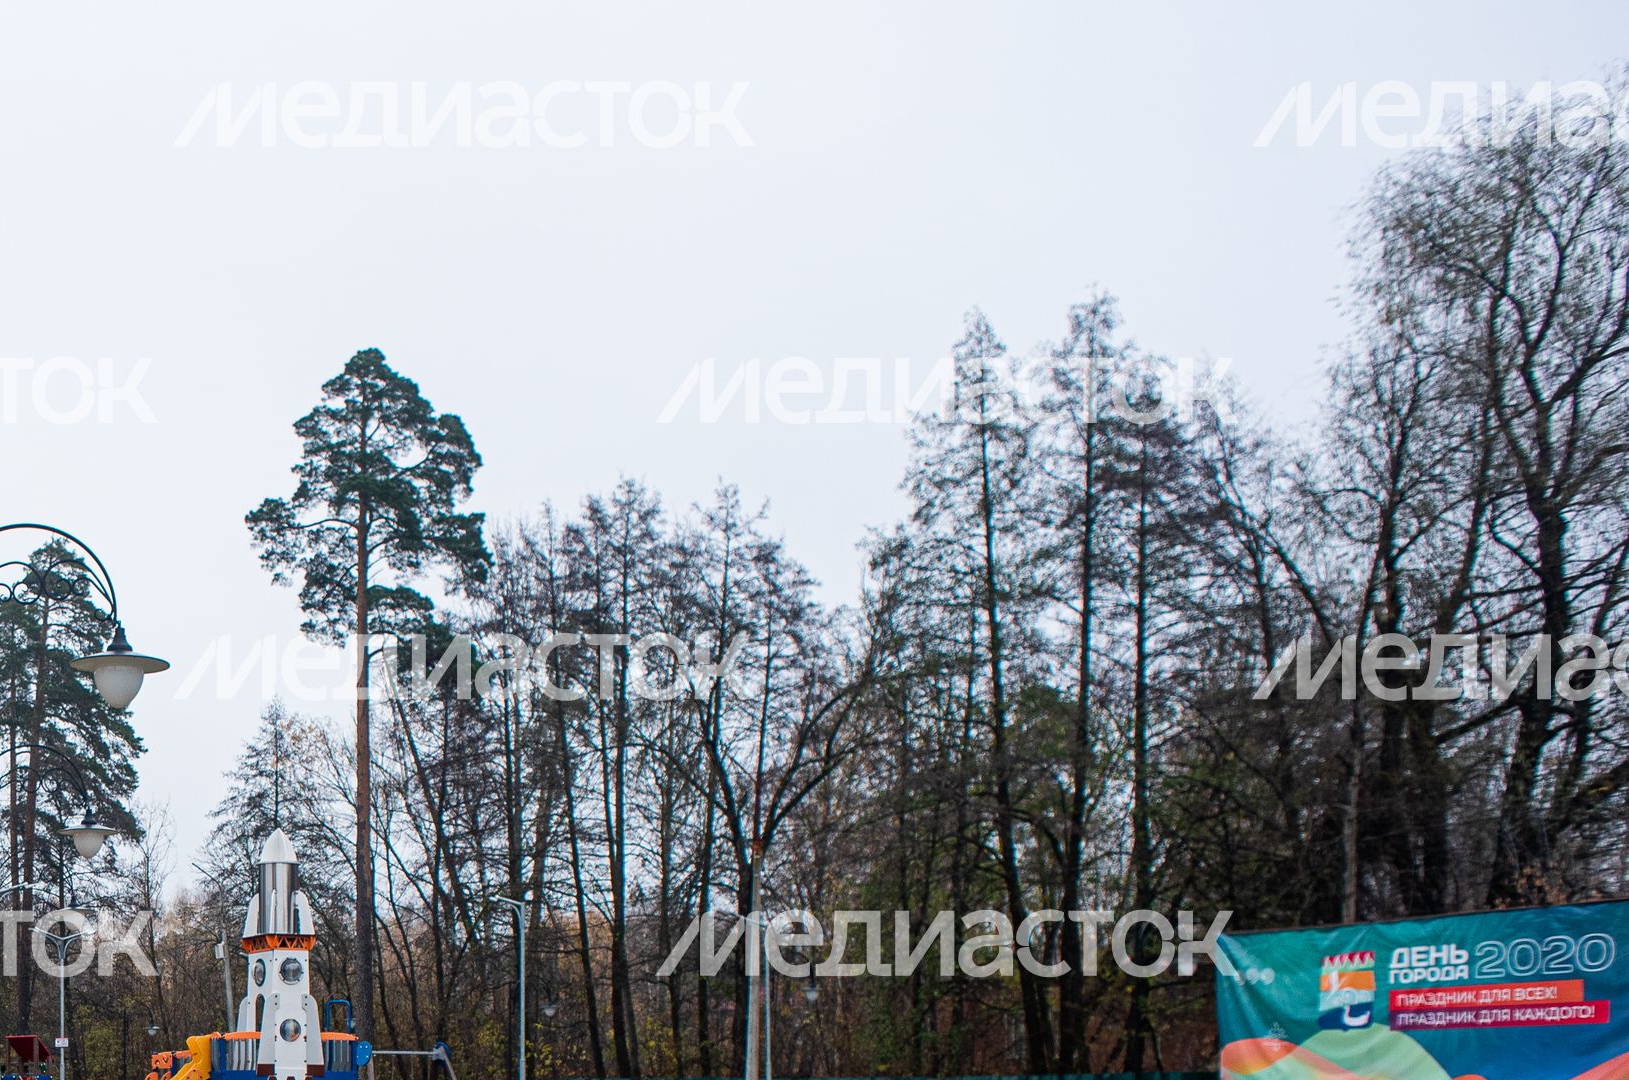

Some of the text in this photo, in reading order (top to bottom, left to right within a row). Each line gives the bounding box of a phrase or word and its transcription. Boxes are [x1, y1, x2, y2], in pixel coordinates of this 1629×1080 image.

[1390, 943, 1469, 969] ДЕНЬ
[1474, 932, 1615, 979] 2020
[1389, 964, 1469, 984] ГОРОДА
[1396, 985, 1558, 1007] ПРАЗДНИК ДЛЯ ВСЕХ!
[1396, 1004, 1596, 1026] ПРАЗДНИК ДЛЯ КАЖДОГО!
